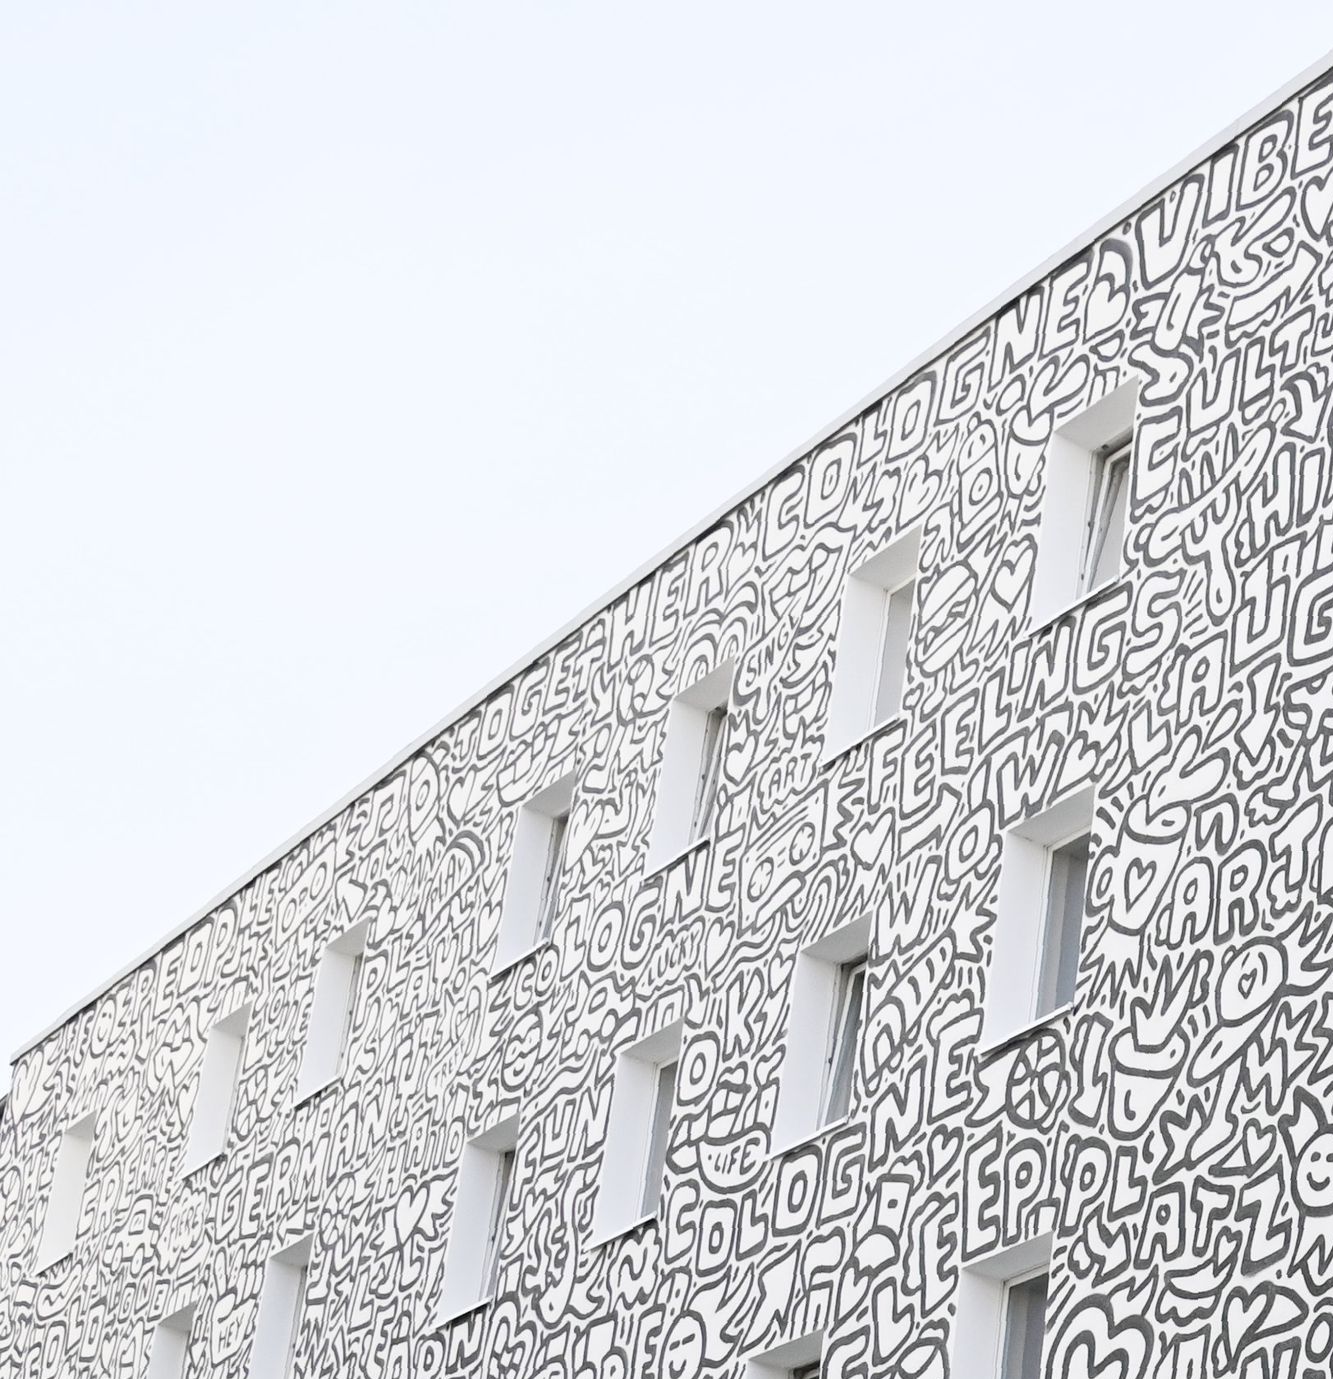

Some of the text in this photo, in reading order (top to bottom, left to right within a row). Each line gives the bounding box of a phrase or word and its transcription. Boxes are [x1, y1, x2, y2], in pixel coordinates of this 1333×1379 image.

[762, 246, 1093, 566] COLOGNE
[452, 517, 733, 789] TOGETHER
[869, 557, 1185, 822] FEELINGS
[769, 743, 813, 808] ART
[132, 862, 281, 1038] PEOPLE
[428, 846, 466, 915] PLAY
[515, 790, 745, 1037] COLOGNE
[1166, 794, 1323, 951] ART
[648, 922, 698, 986] LUCKY
[509, 1072, 614, 1214] FUN
[664, 1001, 983, 1282] COLOGNE
[714, 1128, 755, 1187] LIFE
[218, 1312, 241, 1355] HEY
